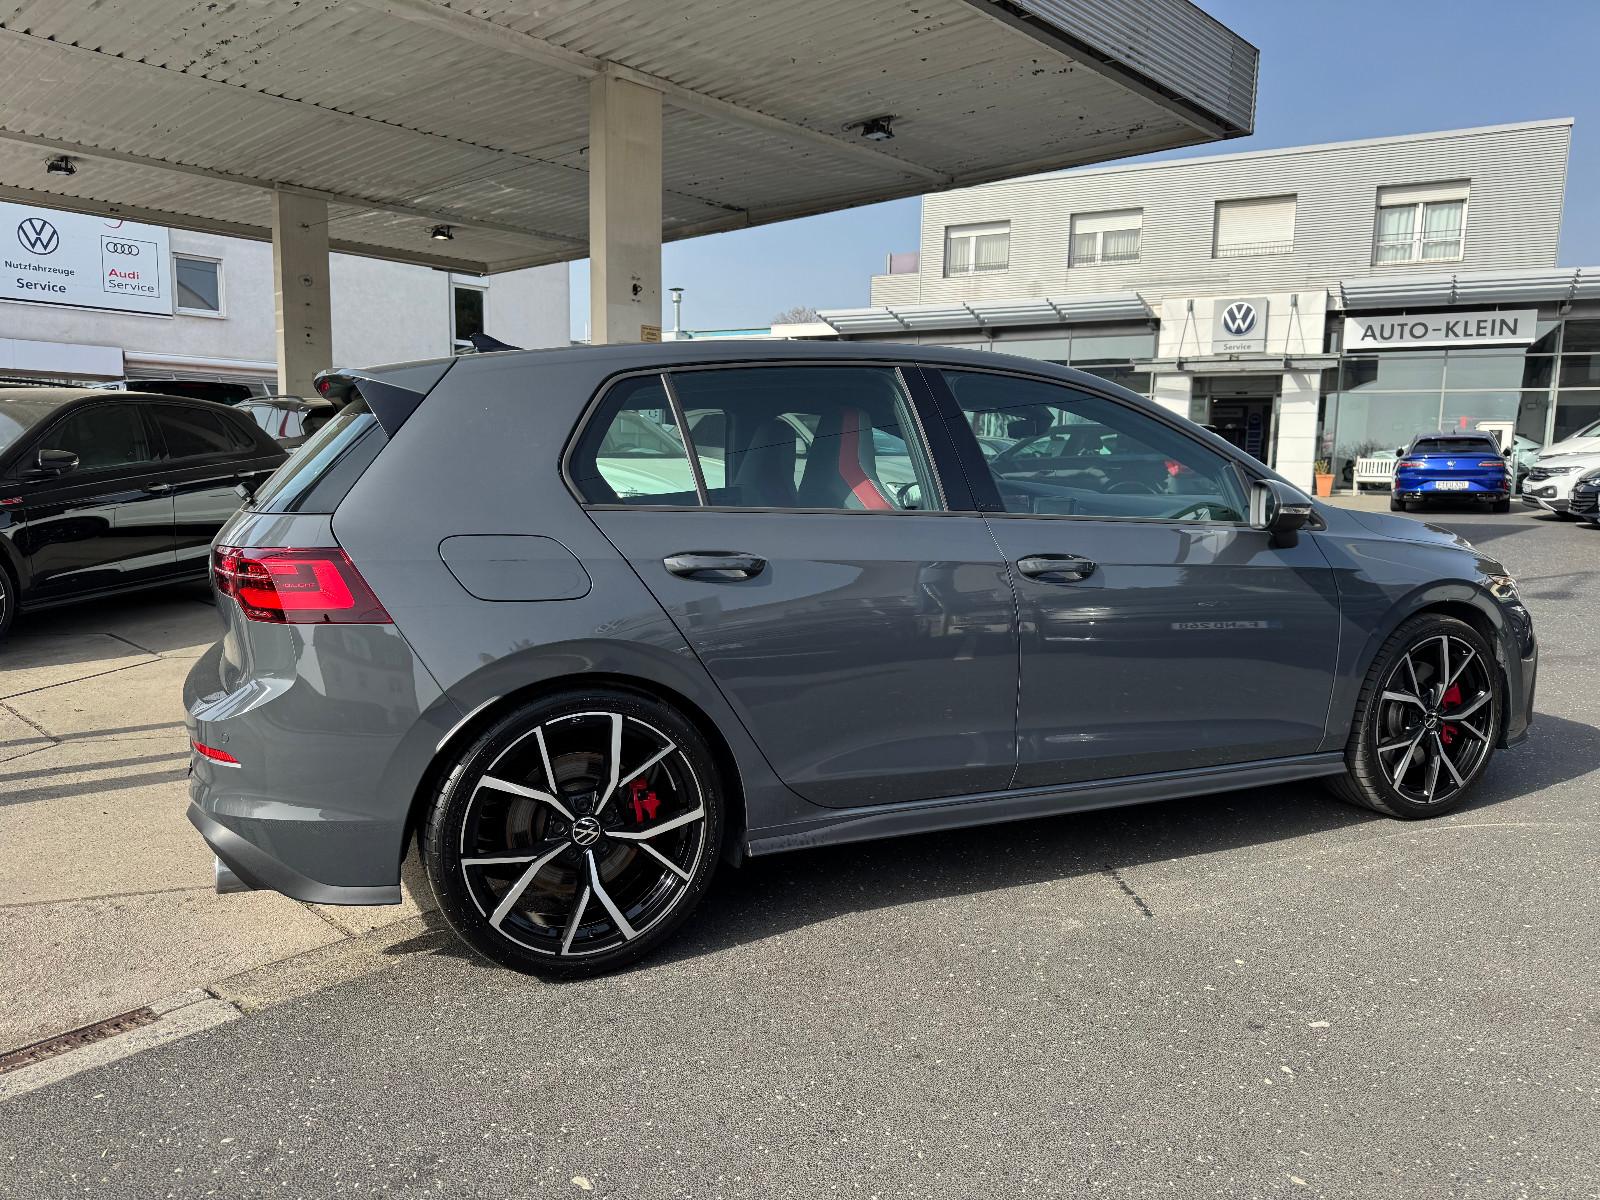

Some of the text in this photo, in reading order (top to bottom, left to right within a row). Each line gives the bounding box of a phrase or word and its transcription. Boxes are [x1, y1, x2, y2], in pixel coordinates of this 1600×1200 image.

[5, 260, 75, 276] Nutzfahrzeuge
[109, 268, 140, 280] Audi
[16, 278, 67, 293] Service
[109, 279, 155, 293] Service
[1361, 318, 1518, 341] AUTO-KLEIN
[1223, 343, 1252, 351] Service
